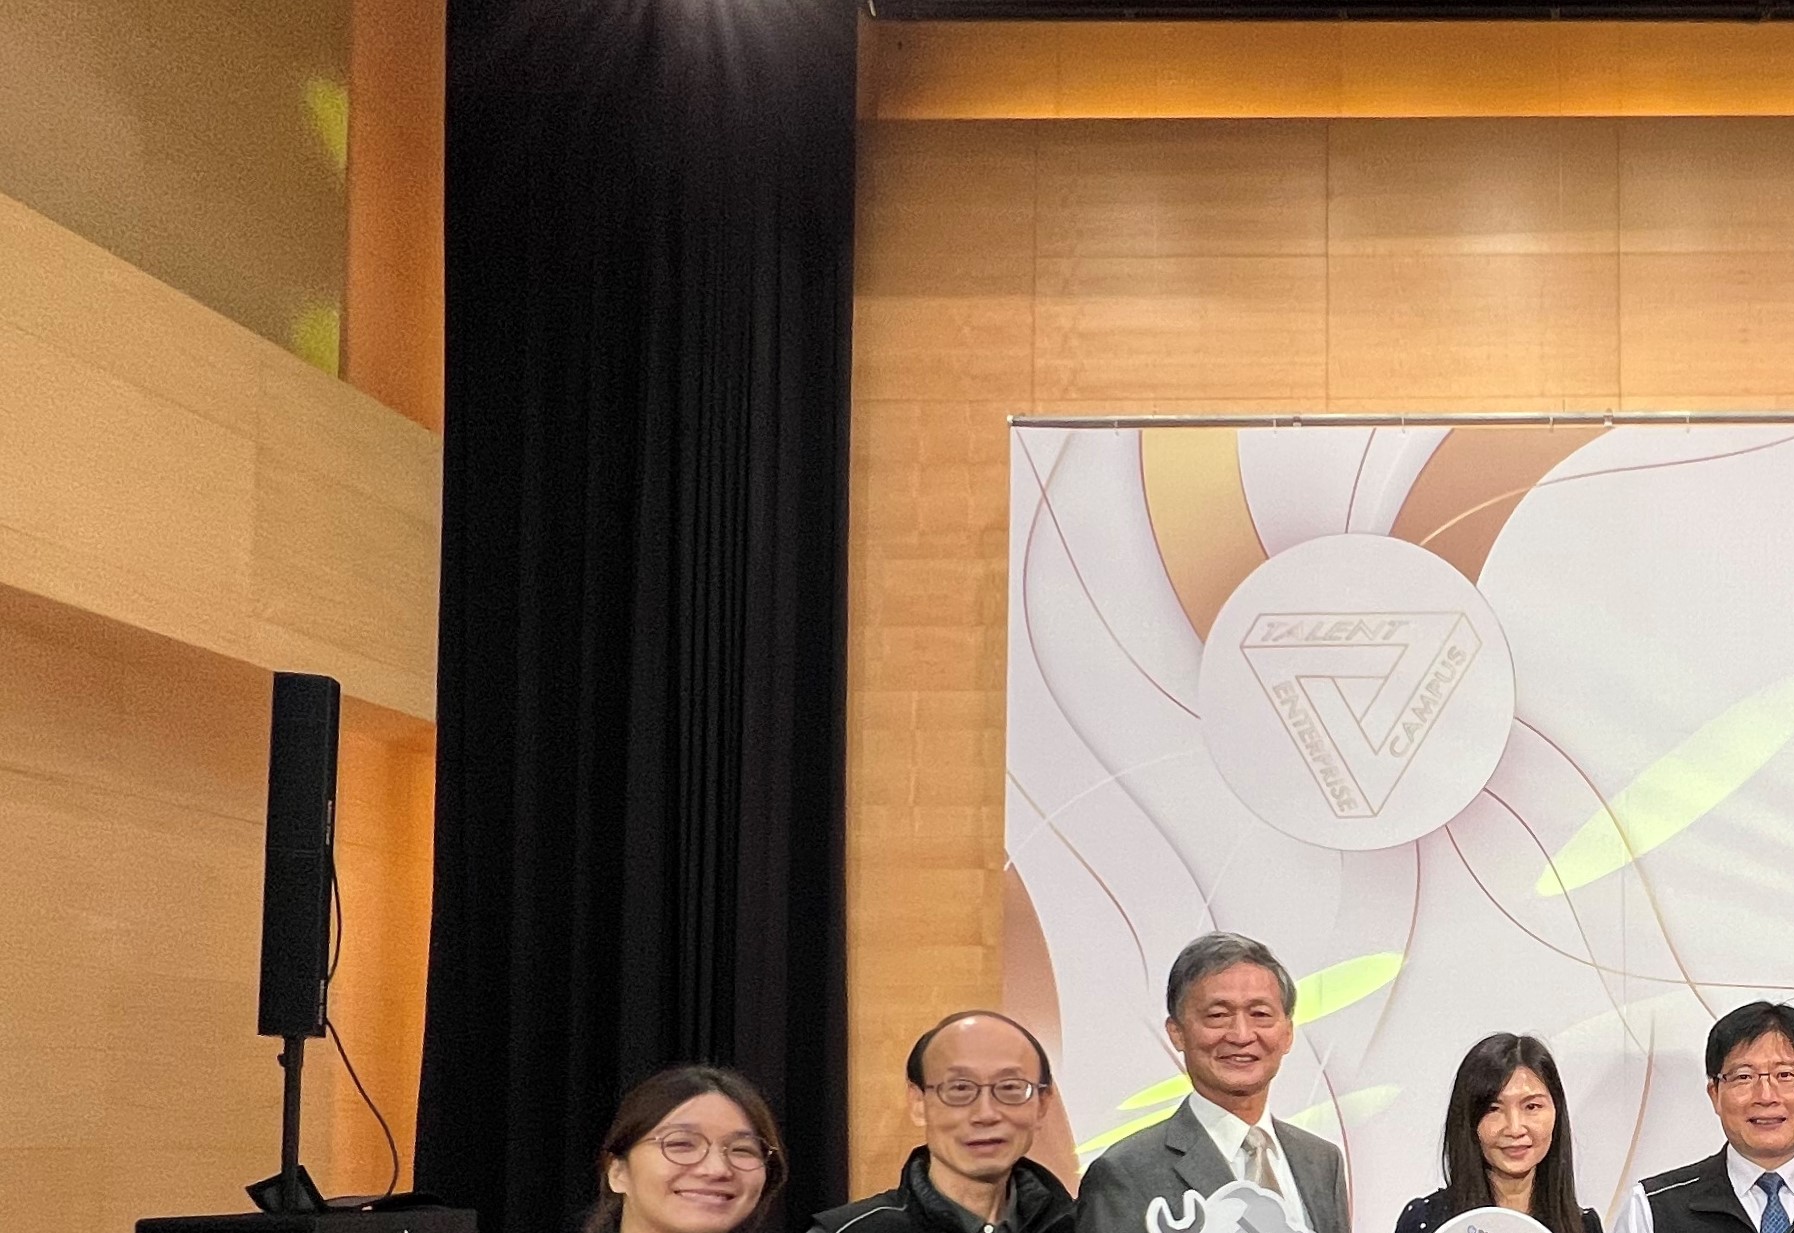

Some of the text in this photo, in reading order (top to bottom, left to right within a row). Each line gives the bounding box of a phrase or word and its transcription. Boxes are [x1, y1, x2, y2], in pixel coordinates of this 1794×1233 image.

[1260, 618, 1410, 643] TALENT
[1272, 681, 1358, 813] ENTERPRISE
[1388, 645, 1467, 758] CAMPUS
